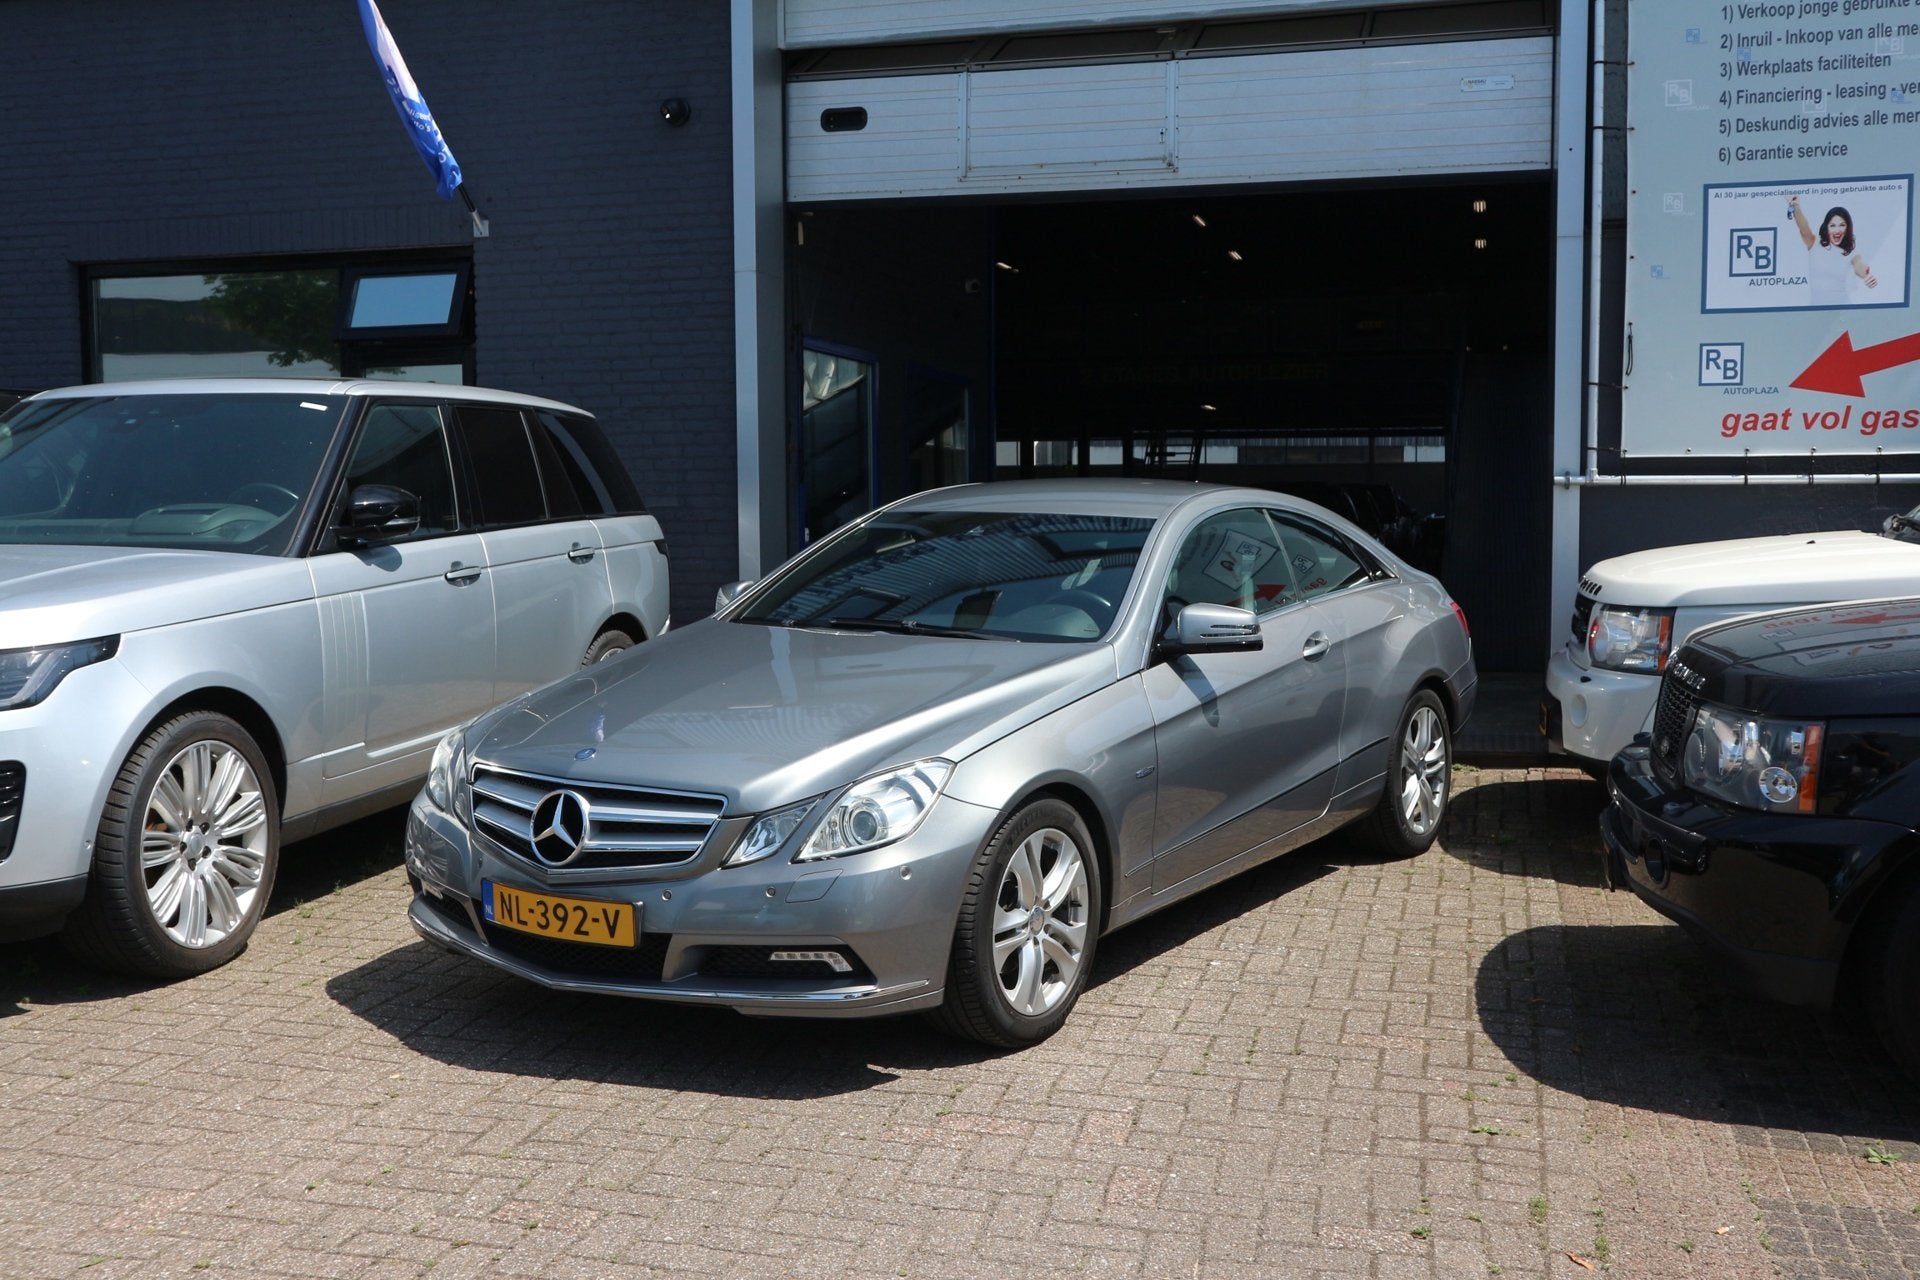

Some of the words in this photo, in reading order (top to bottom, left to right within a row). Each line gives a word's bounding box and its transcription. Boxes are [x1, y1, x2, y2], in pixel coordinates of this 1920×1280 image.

[1721, 5, 1733, 23] 1)
[1738, 3, 1795, 19] Verkoop
[1798, 0, 1838, 18] jonge
[1720, 33, 1733, 52] 2)
[1737, 31, 1772, 48] Inruil
[1785, 28, 1834, 45] Inkoop
[1838, 28, 1863, 41] van
[1868, 23, 1893, 39] alle
[1720, 62, 1732, 81] 3)
[1736, 59, 1813, 78] Werkplaats
[1817, 53, 1891, 71] faciliteiten
[1719, 90, 1732, 109] 4)
[1736, 86, 1822, 105] Financiering
[1836, 82, 1886, 100] leasing
[1719, 118, 1731, 137] 5)
[1735, 115, 1809, 134] Deskundig
[1814, 113, 1859, 129] advies
[1864, 110, 1888, 126] alle
[1718, 148, 1731, 165] 6)
[1735, 144, 1794, 162] Garantie
[1798, 142, 1848, 158] service
[1734, 192, 1749, 200] jaar
[1820, 187, 1838, 196] jong
[1840, 185, 1877, 195] gebruikte
[1736, 235, 1772, 270] RB
[1748, 277, 1808, 287] AUTOPLAZA
[1705, 349, 1739, 380] RB
[1723, 386, 1779, 396] AUTOPLAZA
[1720, 407, 1793, 438] gaat
[1802, 405, 1853, 430] vol
[1860, 408, 1920, 436] gas
[485, 904, 493, 915] NL
[500, 891, 620, 938] NL-392-V
